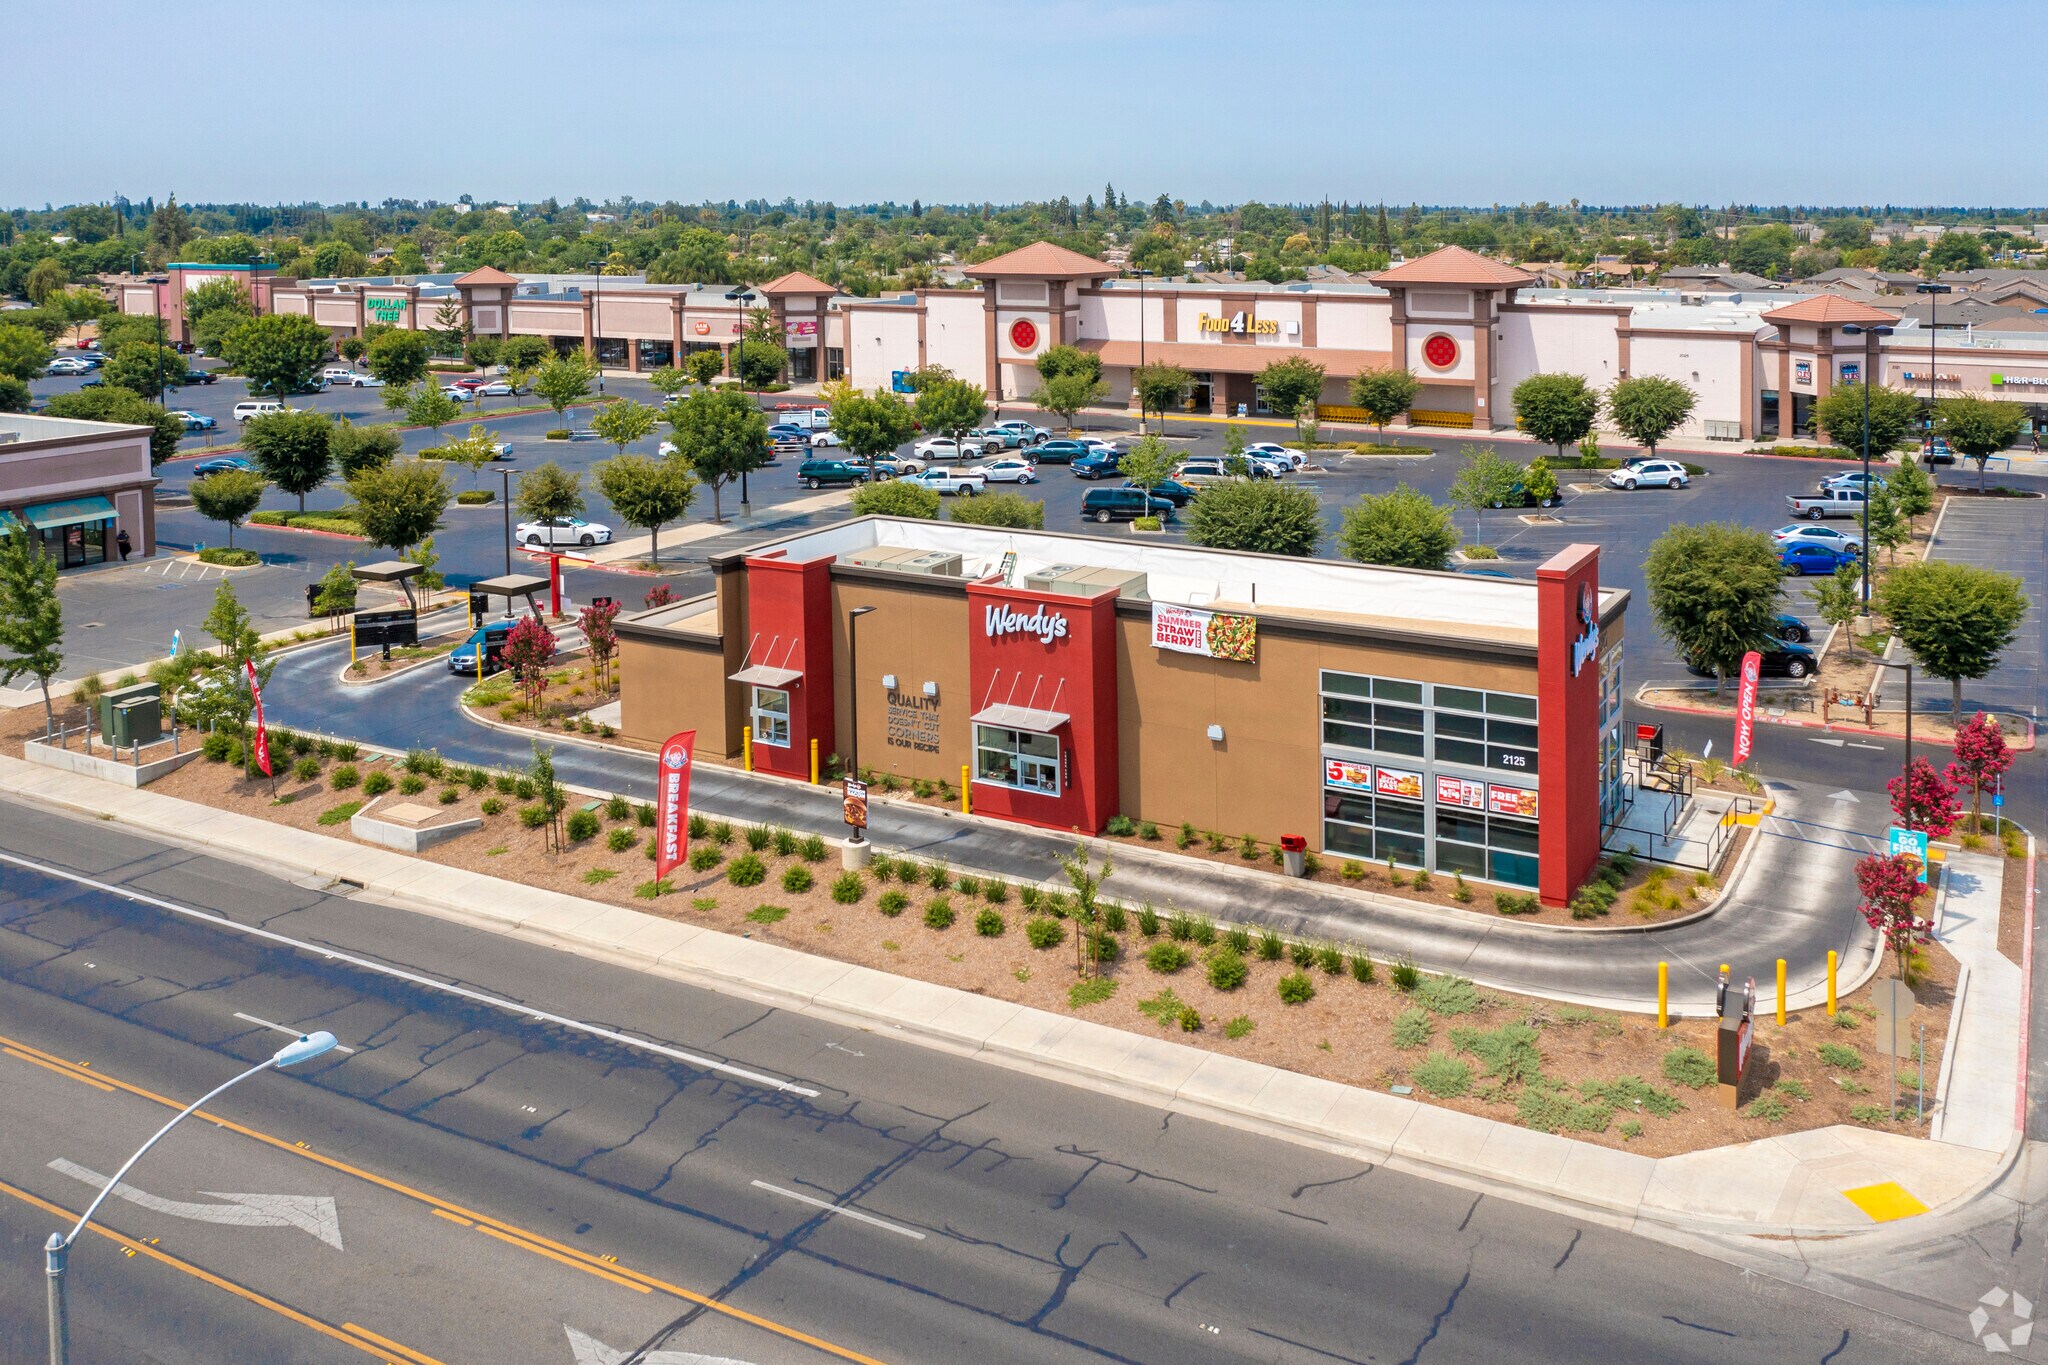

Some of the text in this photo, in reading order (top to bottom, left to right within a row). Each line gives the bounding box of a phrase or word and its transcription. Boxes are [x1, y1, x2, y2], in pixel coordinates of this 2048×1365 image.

[367, 298, 407, 310] DOLLAR
[374, 310, 400, 321] TREE
[1230, 311, 1246, 333] 4
[2006, 375, 2030, 385] H&R
[985, 604, 1068, 644] Wendy's
[1157, 614, 1202, 629] SUMMER
[1157, 623, 1195, 637] STRAW
[1157, 632, 1195, 647] BERRY
[887, 691, 940, 712] QUALITY
[888, 706, 939, 722] SERVICE THAT
[1738, 682, 1754, 757] NOW OPEN
[923, 722, 940, 732] CUT
[888, 726, 940, 745] CORNERS
[887, 737, 940, 755] IS OUR RECIPE
[1502, 754, 1526, 767] 2125
[1491, 791, 1518, 803] FREE
[665, 773, 681, 861] BREAKFAST
[1898, 836, 1918, 847] GO
